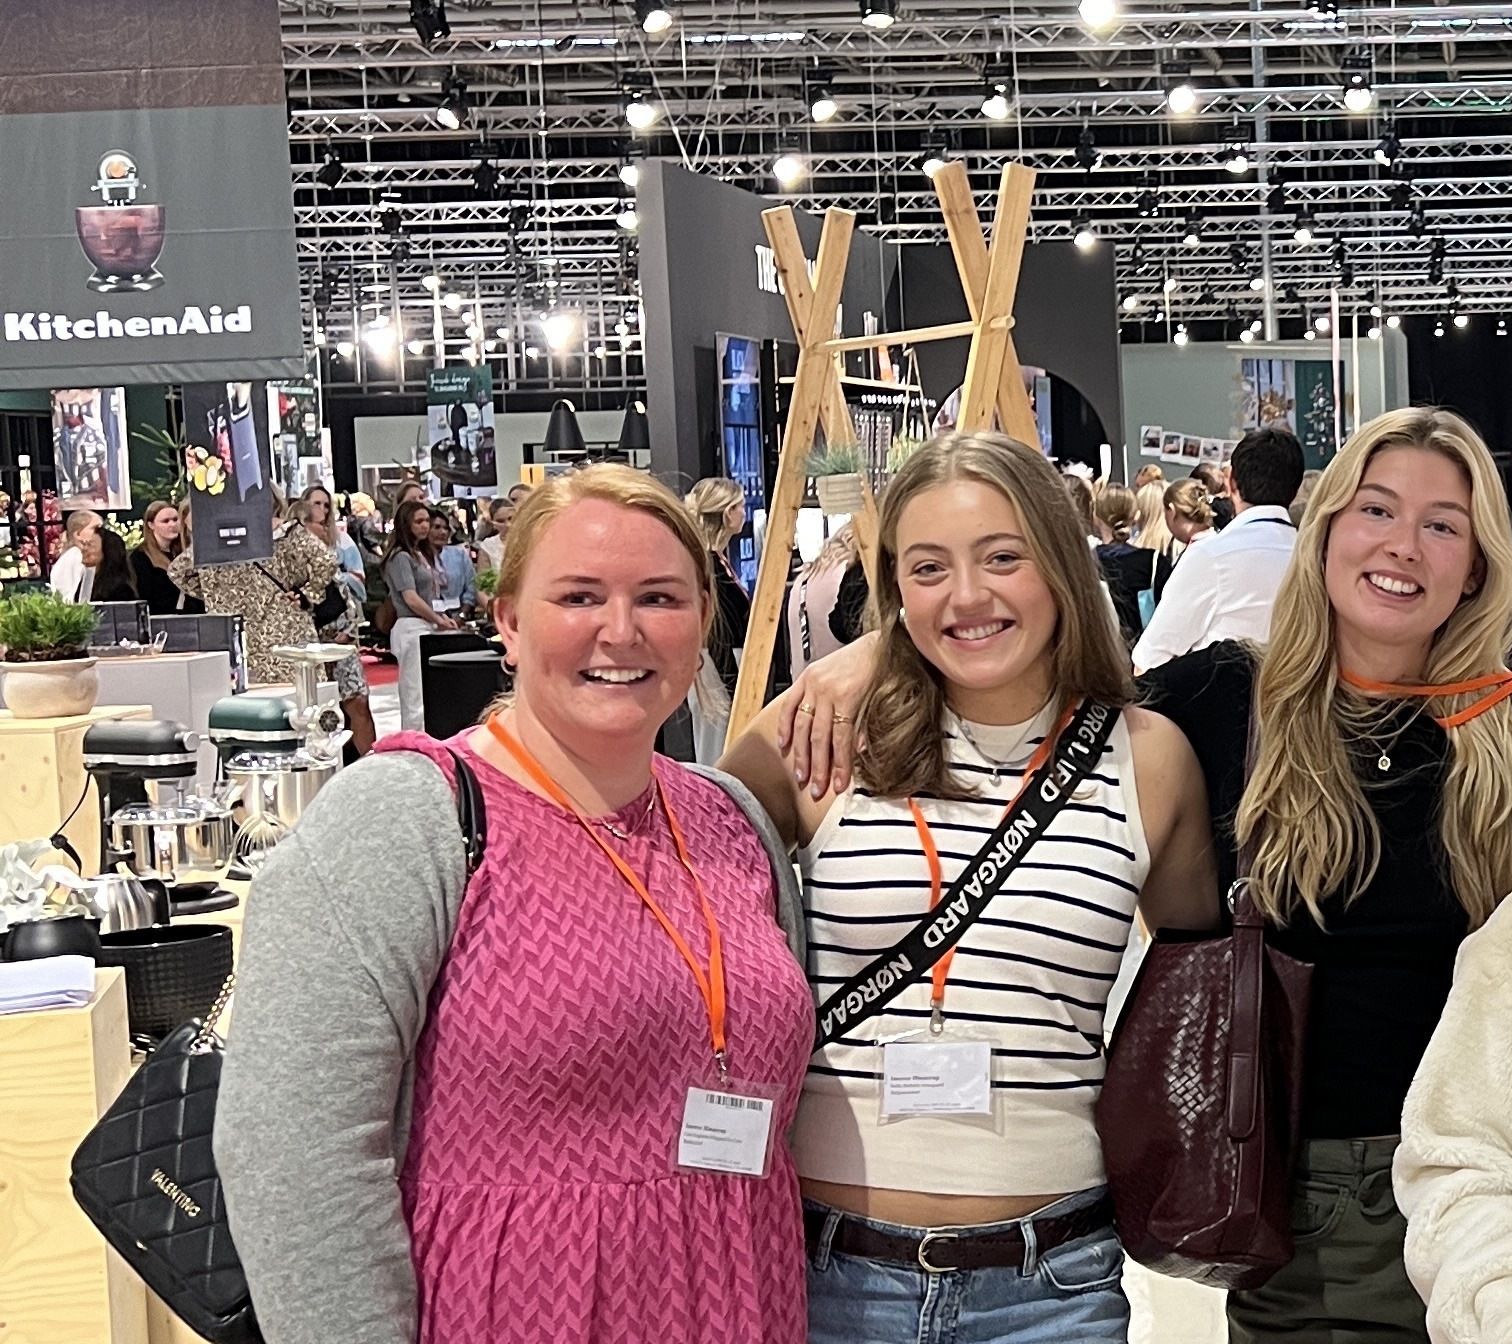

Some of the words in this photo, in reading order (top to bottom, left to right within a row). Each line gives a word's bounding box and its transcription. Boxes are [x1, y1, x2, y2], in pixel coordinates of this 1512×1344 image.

[4, 305, 252, 341] KitchenAid
[923, 809, 1038, 948] NØRGAARD
[820, 953, 914, 1037] NØRGAA
[150, 1167, 201, 1217] VALENTINO
